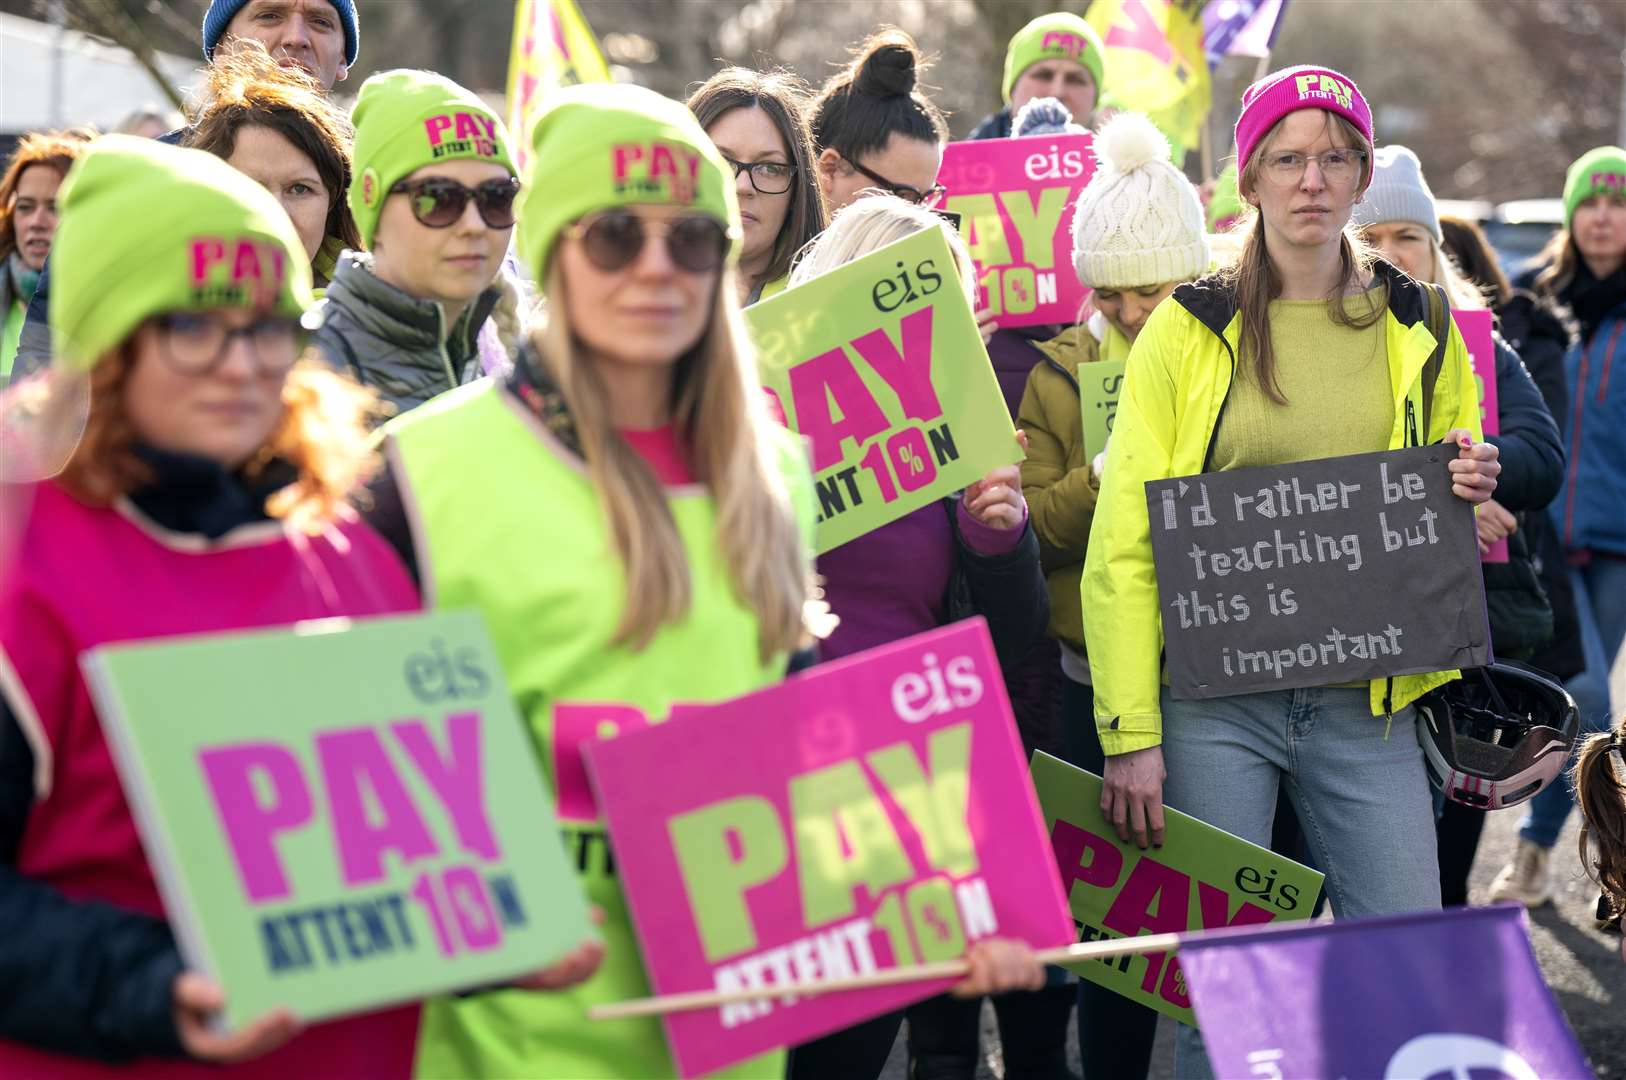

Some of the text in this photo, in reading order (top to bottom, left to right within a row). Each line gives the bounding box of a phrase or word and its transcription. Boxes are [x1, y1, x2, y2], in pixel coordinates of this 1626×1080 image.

[1295, 74, 1353, 98] PAY
[424, 111, 496, 145] PAY
[612, 143, 700, 181] PAY
[1024, 145, 1083, 180] eis
[872, 259, 942, 313] eis
[1161, 462, 1427, 530] I'd rather be
[1188, 506, 1440, 580] teaching but
[1170, 582, 1299, 629] this is
[404, 636, 491, 704] eis
[1222, 623, 1403, 679] important
[891, 652, 983, 722] eis
[196, 710, 501, 903] PAY
[667, 720, 980, 964] PAY
[1234, 866, 1300, 911] eis
